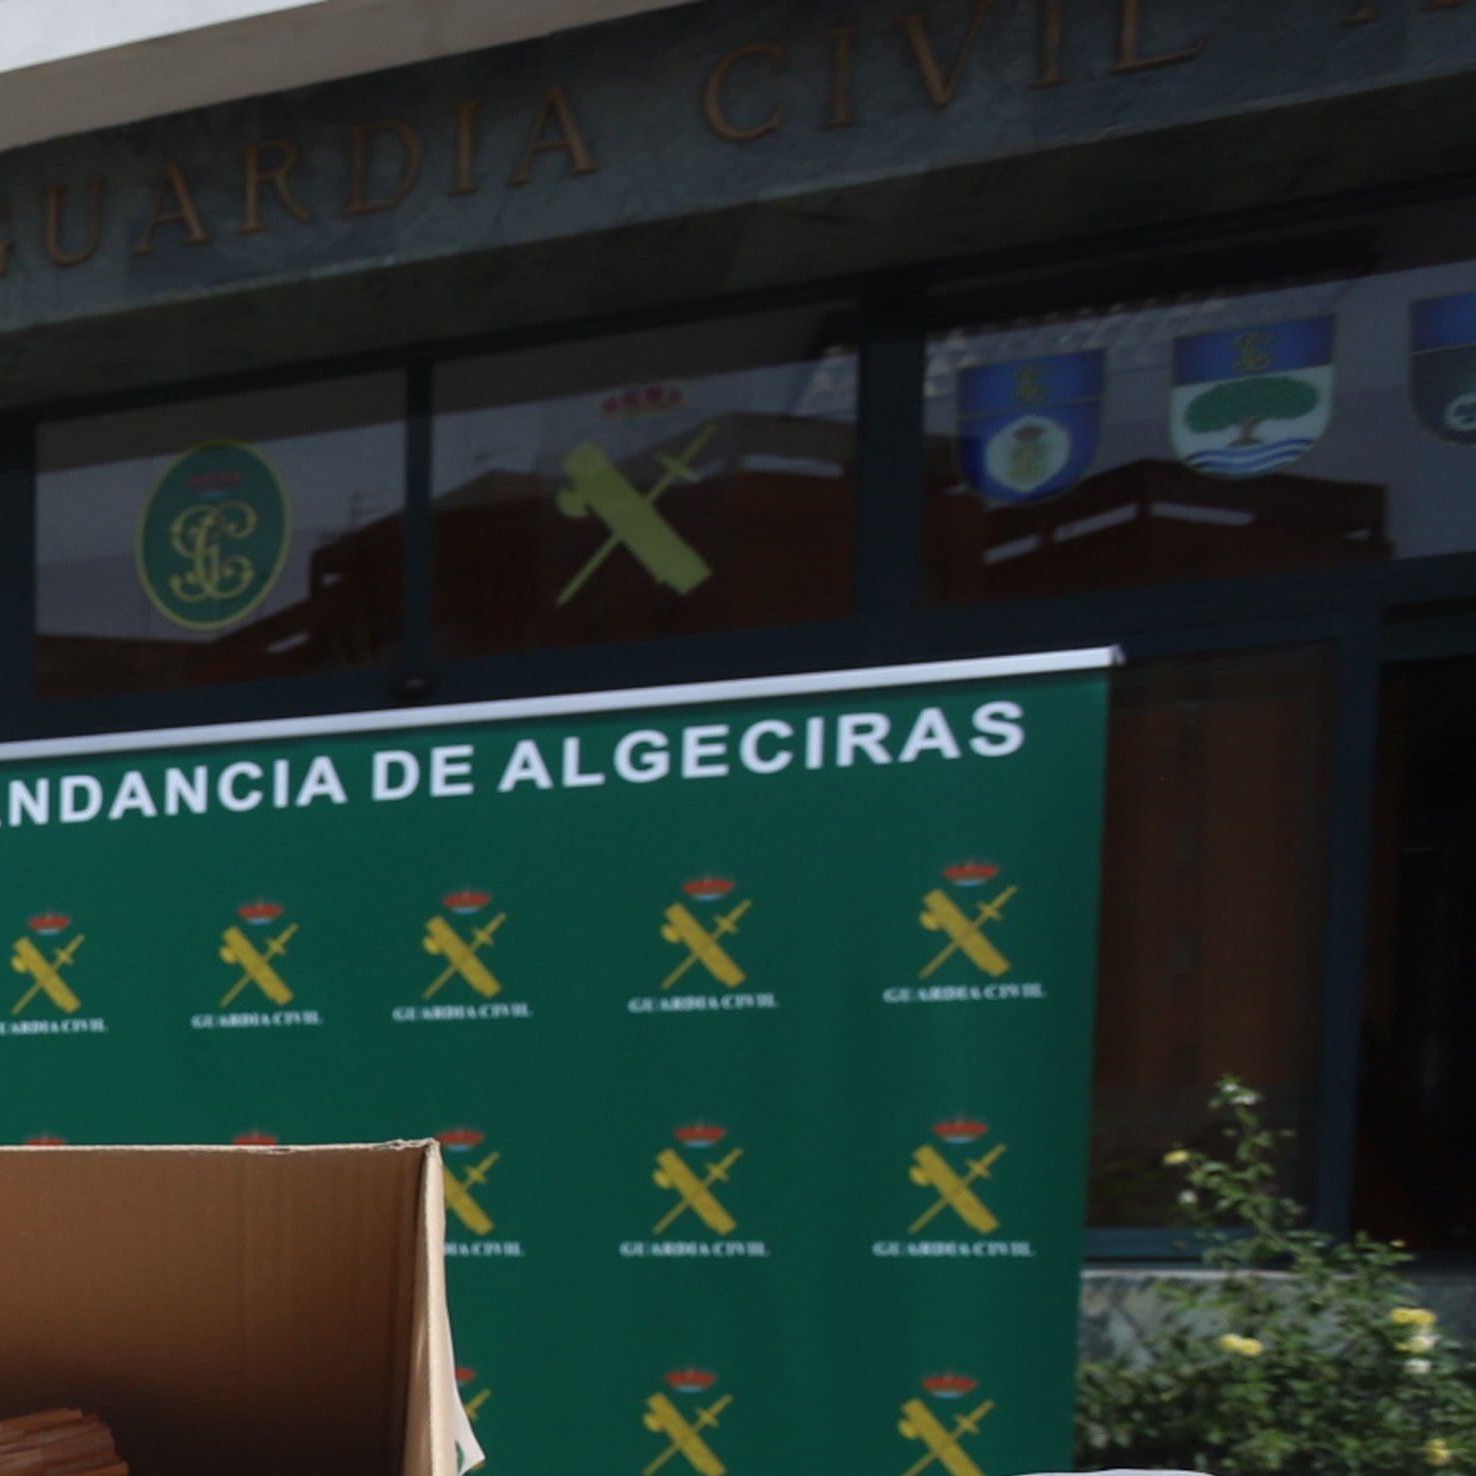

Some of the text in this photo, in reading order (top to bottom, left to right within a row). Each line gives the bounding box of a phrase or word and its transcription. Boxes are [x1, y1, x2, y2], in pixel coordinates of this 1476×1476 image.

[702, 0, 1209, 142] CIVIL
[372, 745, 475, 801] DE
[498, 701, 1026, 793] ALGECIRAS
